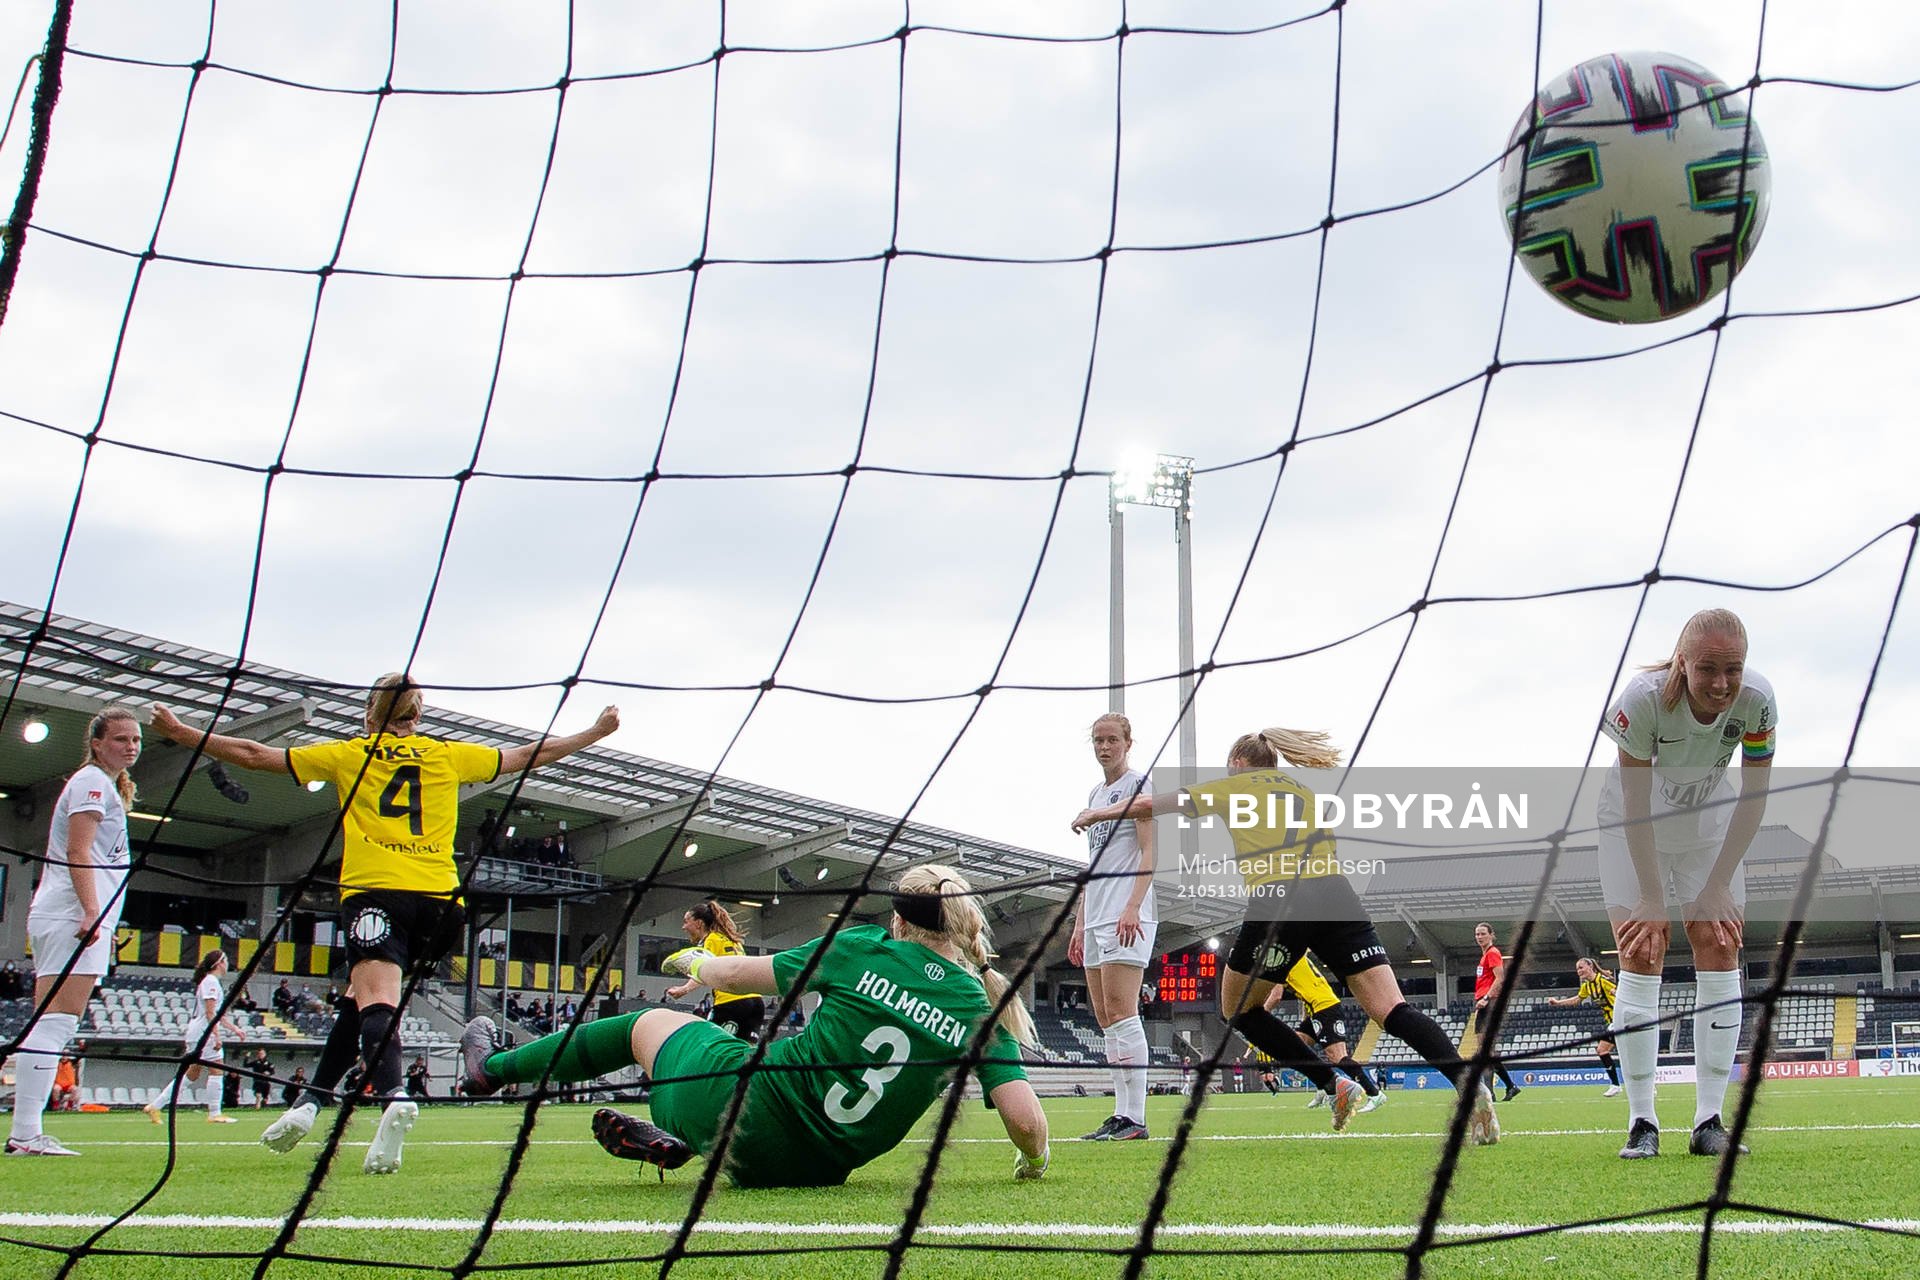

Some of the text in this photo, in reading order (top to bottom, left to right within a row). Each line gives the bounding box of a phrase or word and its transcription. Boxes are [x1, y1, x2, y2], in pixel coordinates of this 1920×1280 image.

[379, 765, 424, 836] 4
[855, 970, 967, 1048] HOLMGREN
[824, 1025, 911, 1124] 3
[1538, 1072, 1610, 1082] SVENSKA CUPE
[1761, 1061, 1848, 1077] AUHAUS
